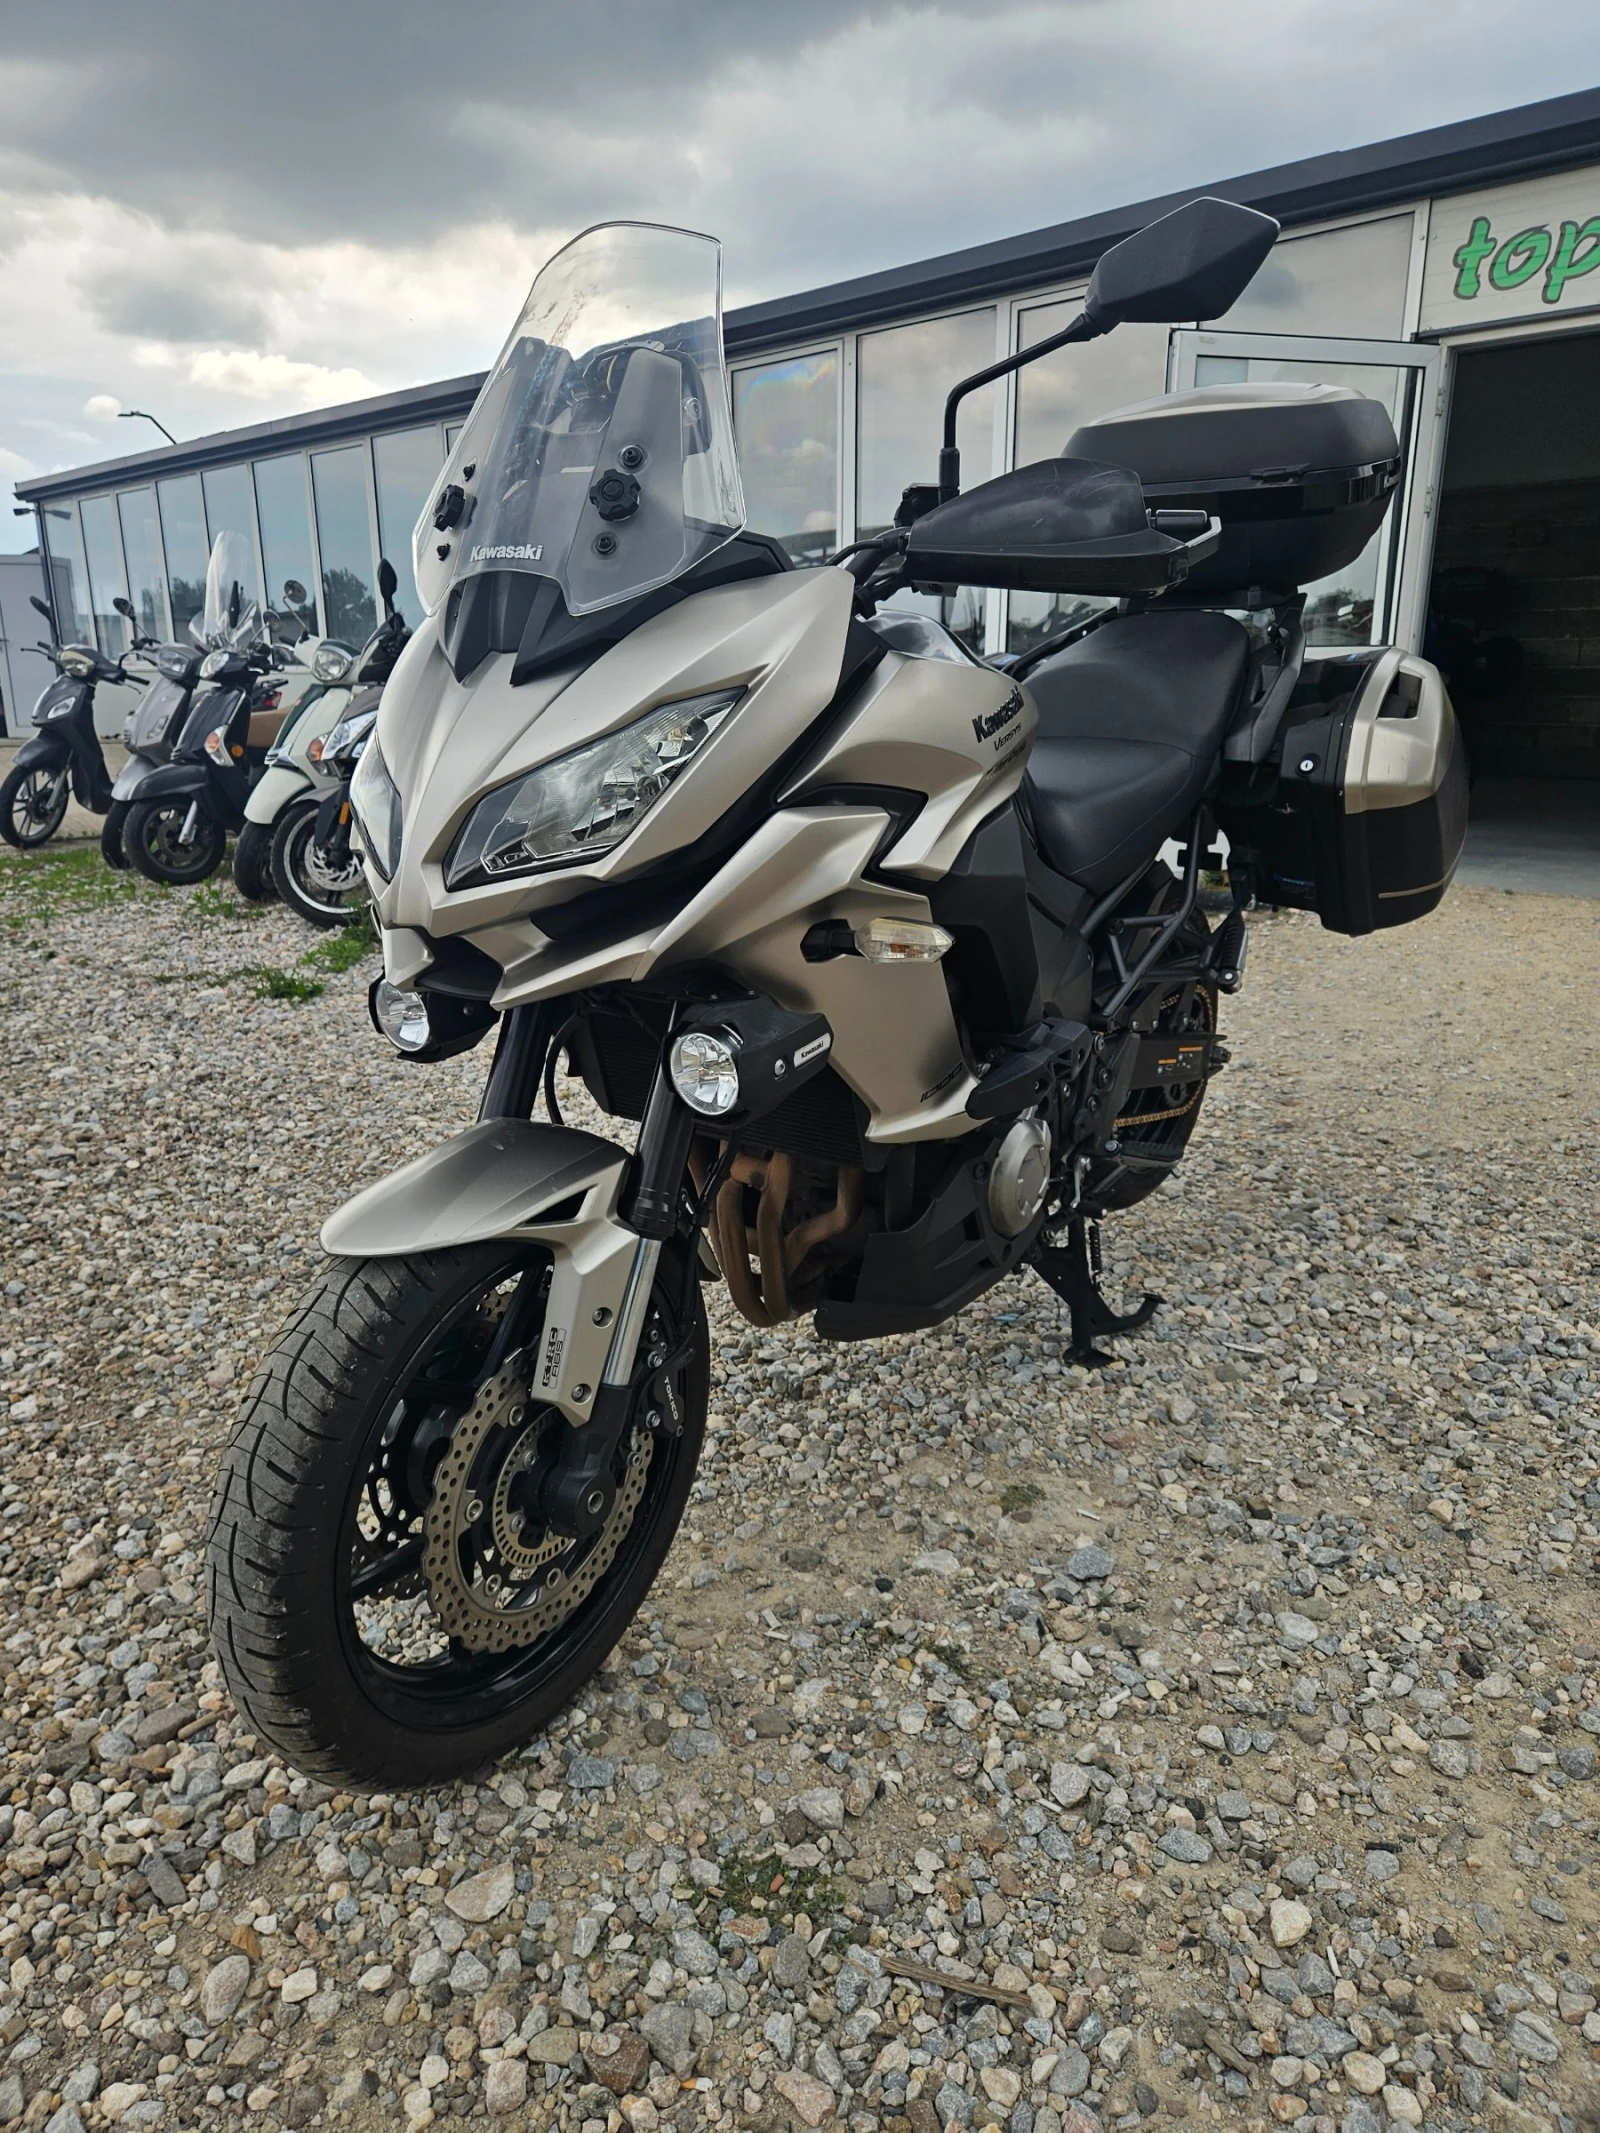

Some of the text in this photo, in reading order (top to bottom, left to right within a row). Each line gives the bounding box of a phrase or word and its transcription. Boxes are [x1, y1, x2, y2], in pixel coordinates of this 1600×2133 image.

[1453, 215, 1600, 304] top
[470, 543, 544, 562] Kawasaki
[971, 684, 1025, 744] Kawasaki
[993, 722, 1022, 752] VERSYS
[801, 1040, 824, 1059] Kawasaki
[920, 1061, 963, 1103] 1000
[664, 1375, 679, 1421] TOKICO
